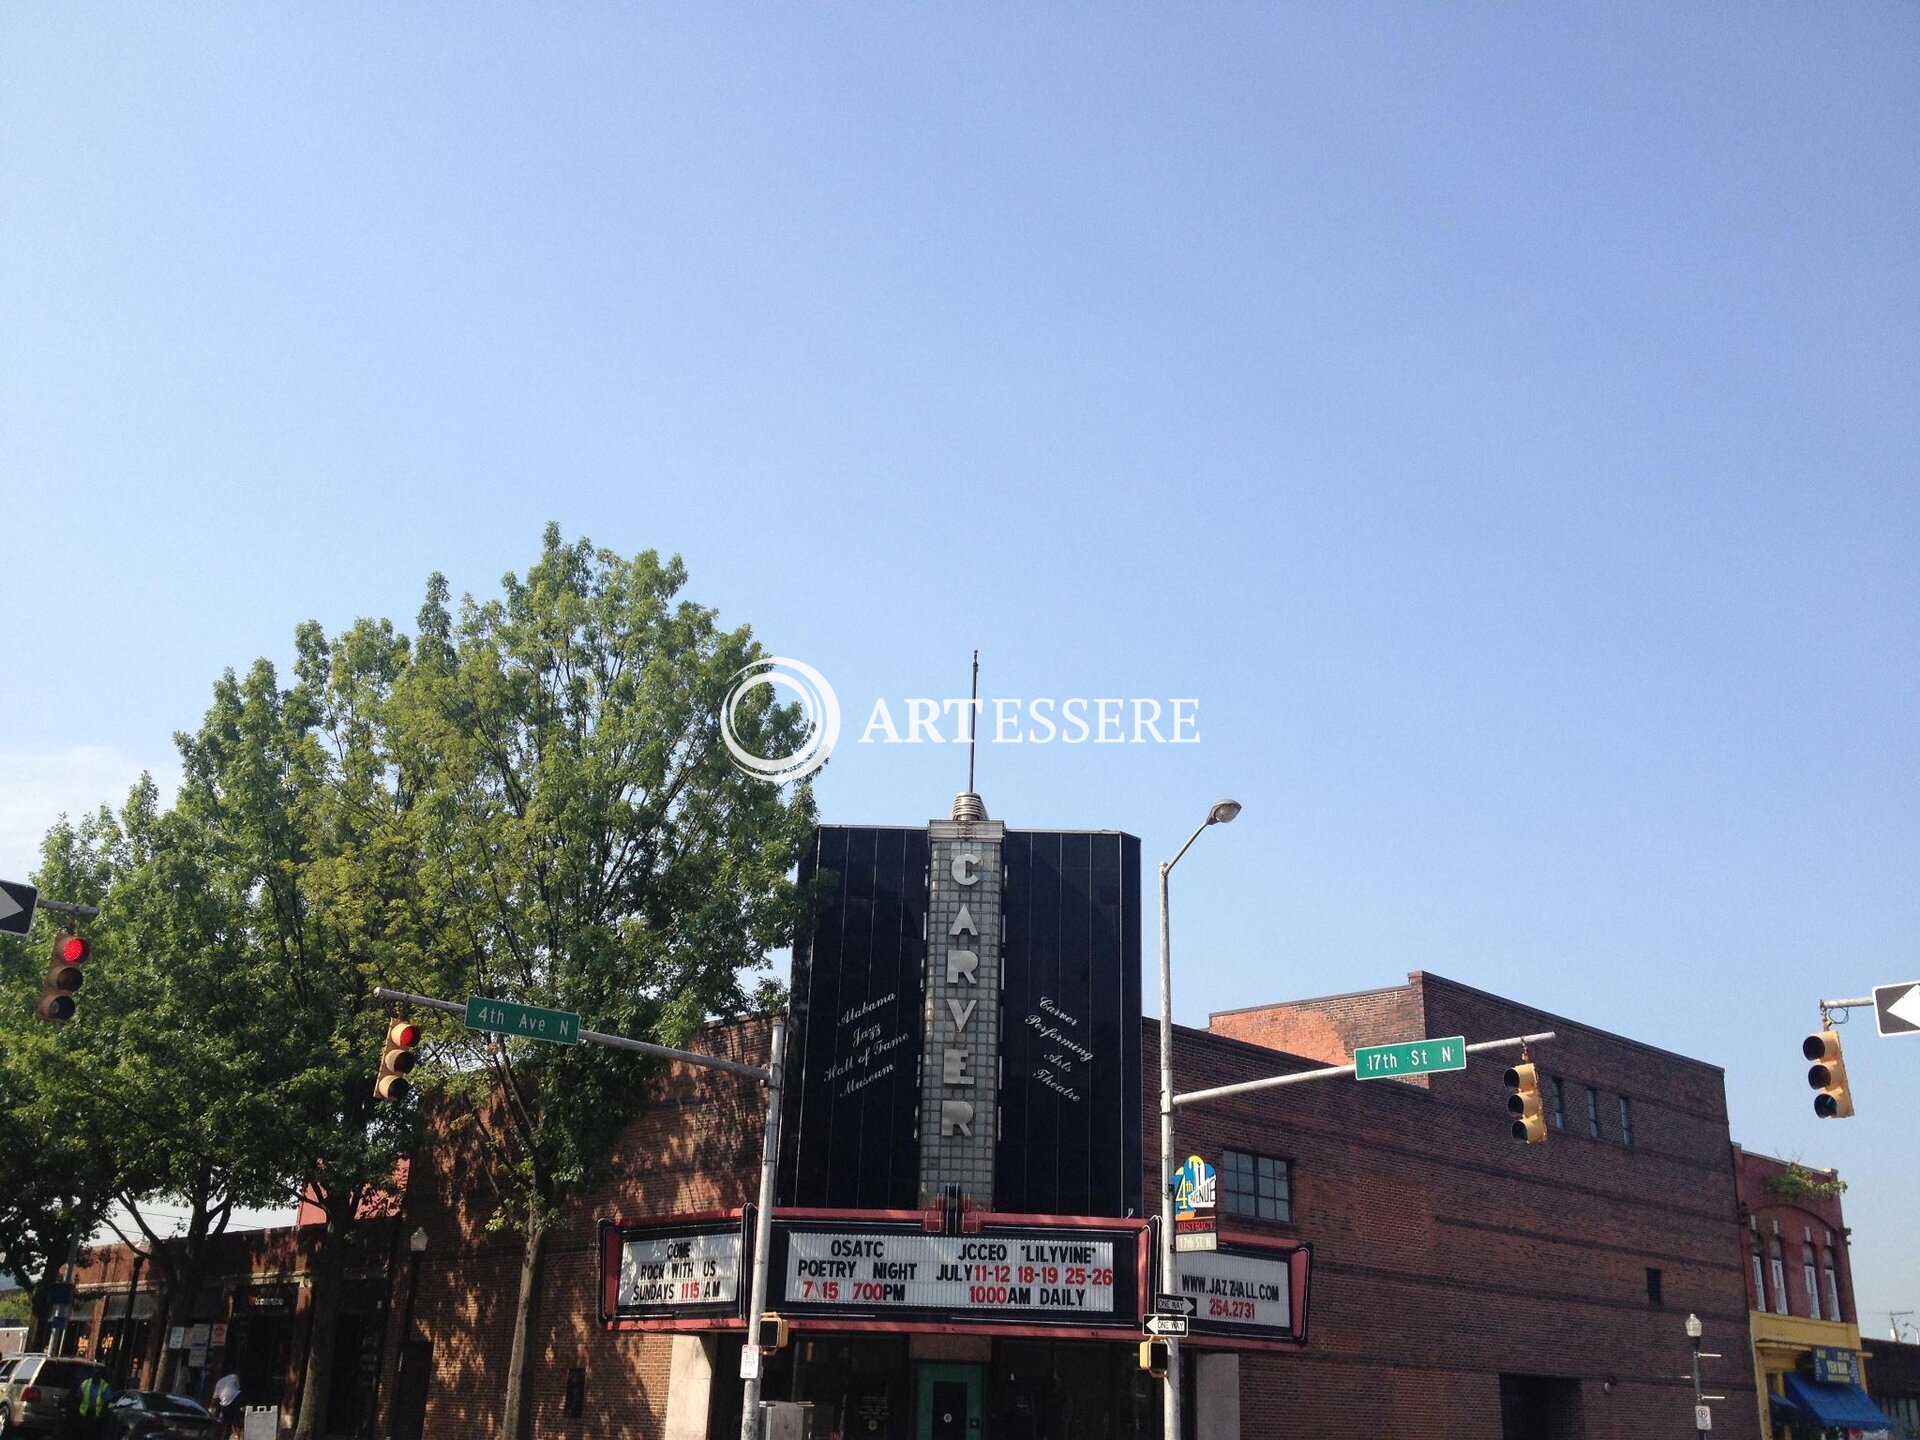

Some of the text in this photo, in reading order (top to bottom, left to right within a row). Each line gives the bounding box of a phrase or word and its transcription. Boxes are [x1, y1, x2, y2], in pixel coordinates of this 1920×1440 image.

[941, 853, 979, 1137] CARVER
[837, 992, 896, 1026] Alabama
[1040, 996, 1077, 1026] Carver
[479, 1006, 568, 1036] 4th Ave N
[853, 1023, 881, 1048] Jazz
[1025, 1014, 1093, 1062] Performing
[824, 1032, 909, 1082] Hall of Fame
[1043, 1054, 1071, 1072] Arts
[1368, 1046, 1451, 1071] 17th St N
[840, 1064, 894, 1097] Museum
[1176, 1175, 1193, 1209] 4th
[1178, 1221, 1213, 1231] DISTRICT
[667, 1242, 691, 1259] COME
[831, 1240, 884, 1257] OSATC
[957, 1244, 1007, 1261] JCCEO
[640, 1261, 716, 1280] ROCK WITH US
[798, 1259, 917, 1280] POETRY NIGHT
[1018, 1265, 1058, 1284] 18-19
[1065, 1268, 1112, 1285] 25-26
[633, 1283, 675, 1301] SUNDAYS
[704, 1281, 720, 1298] AM
[1040, 1288, 1085, 1306] DAILY
[1158, 1299, 1184, 1309] ONE WAY
[1158, 1321, 1184, 1330] ONE WAY
